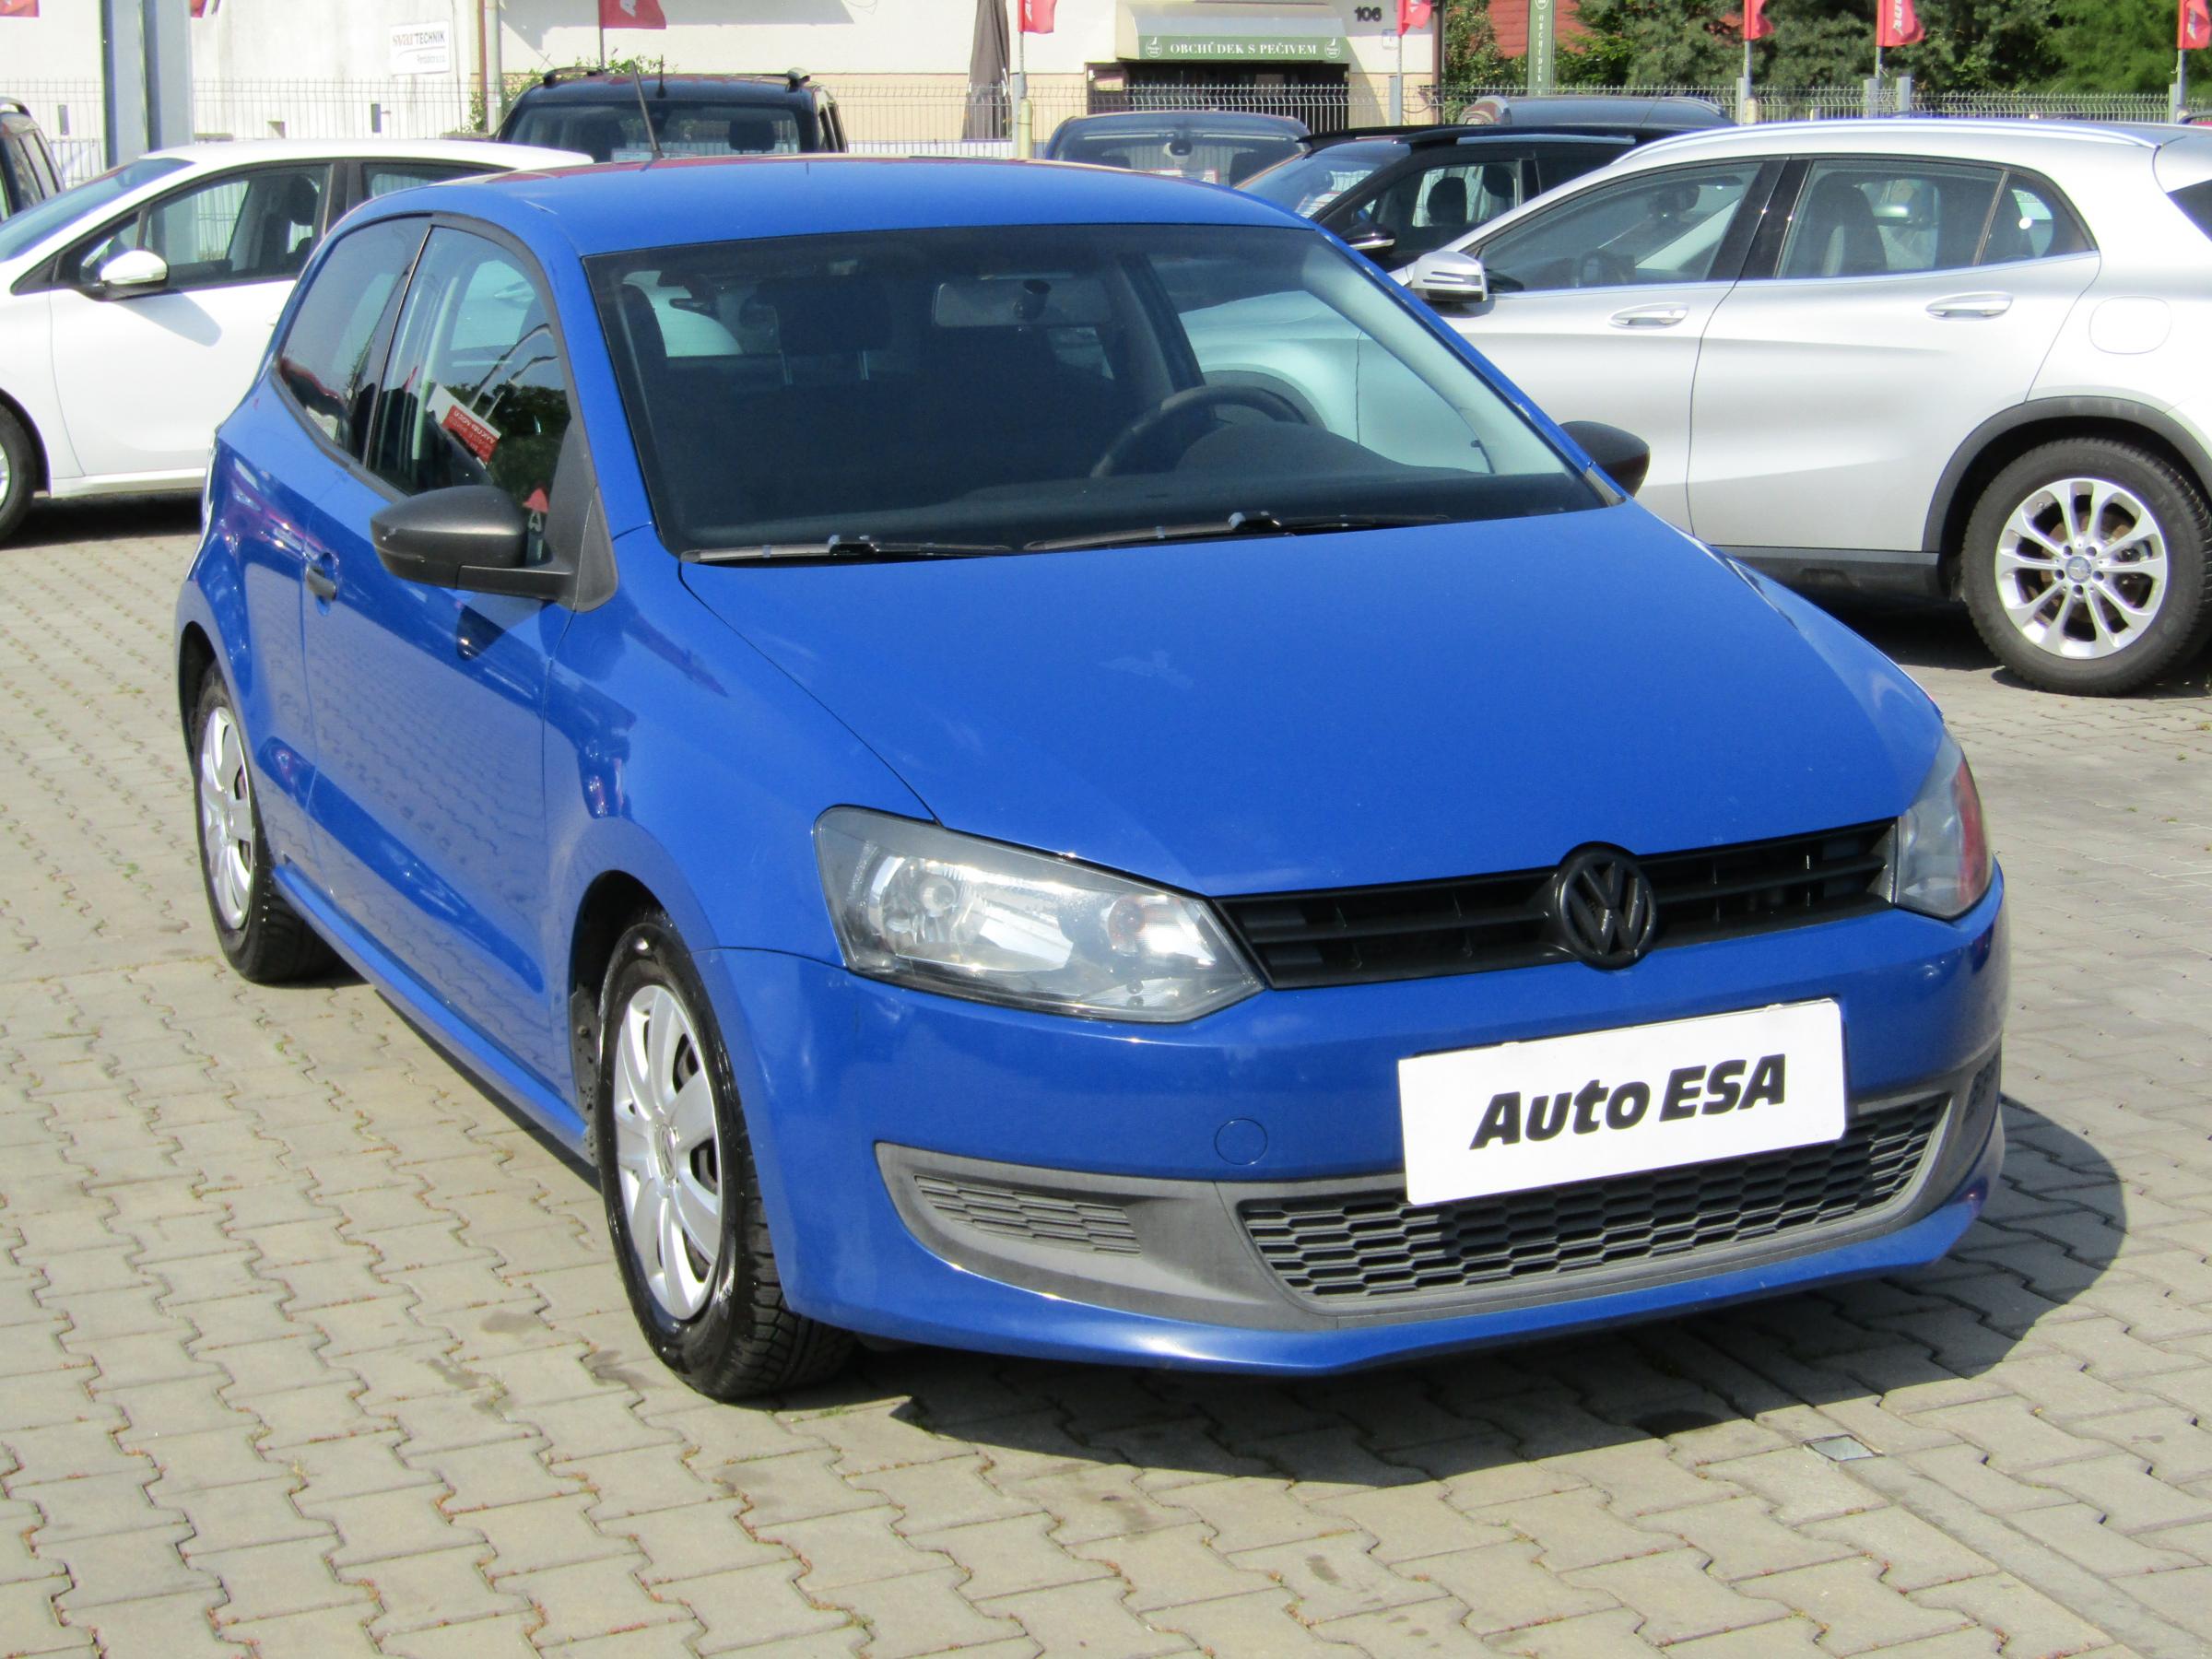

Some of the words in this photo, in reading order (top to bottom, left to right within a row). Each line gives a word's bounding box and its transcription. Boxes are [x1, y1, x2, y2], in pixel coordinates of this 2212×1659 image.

[1354, 6, 1382, 22] 106
[1170, 41, 1244, 54] OBCHŮDEK
[1247, 43, 1256, 54] S
[1260, 41, 1317, 54] PEČIVEM
[1469, 1079, 1651, 1150] Auto
[1659, 1053, 1786, 1123] ESA
